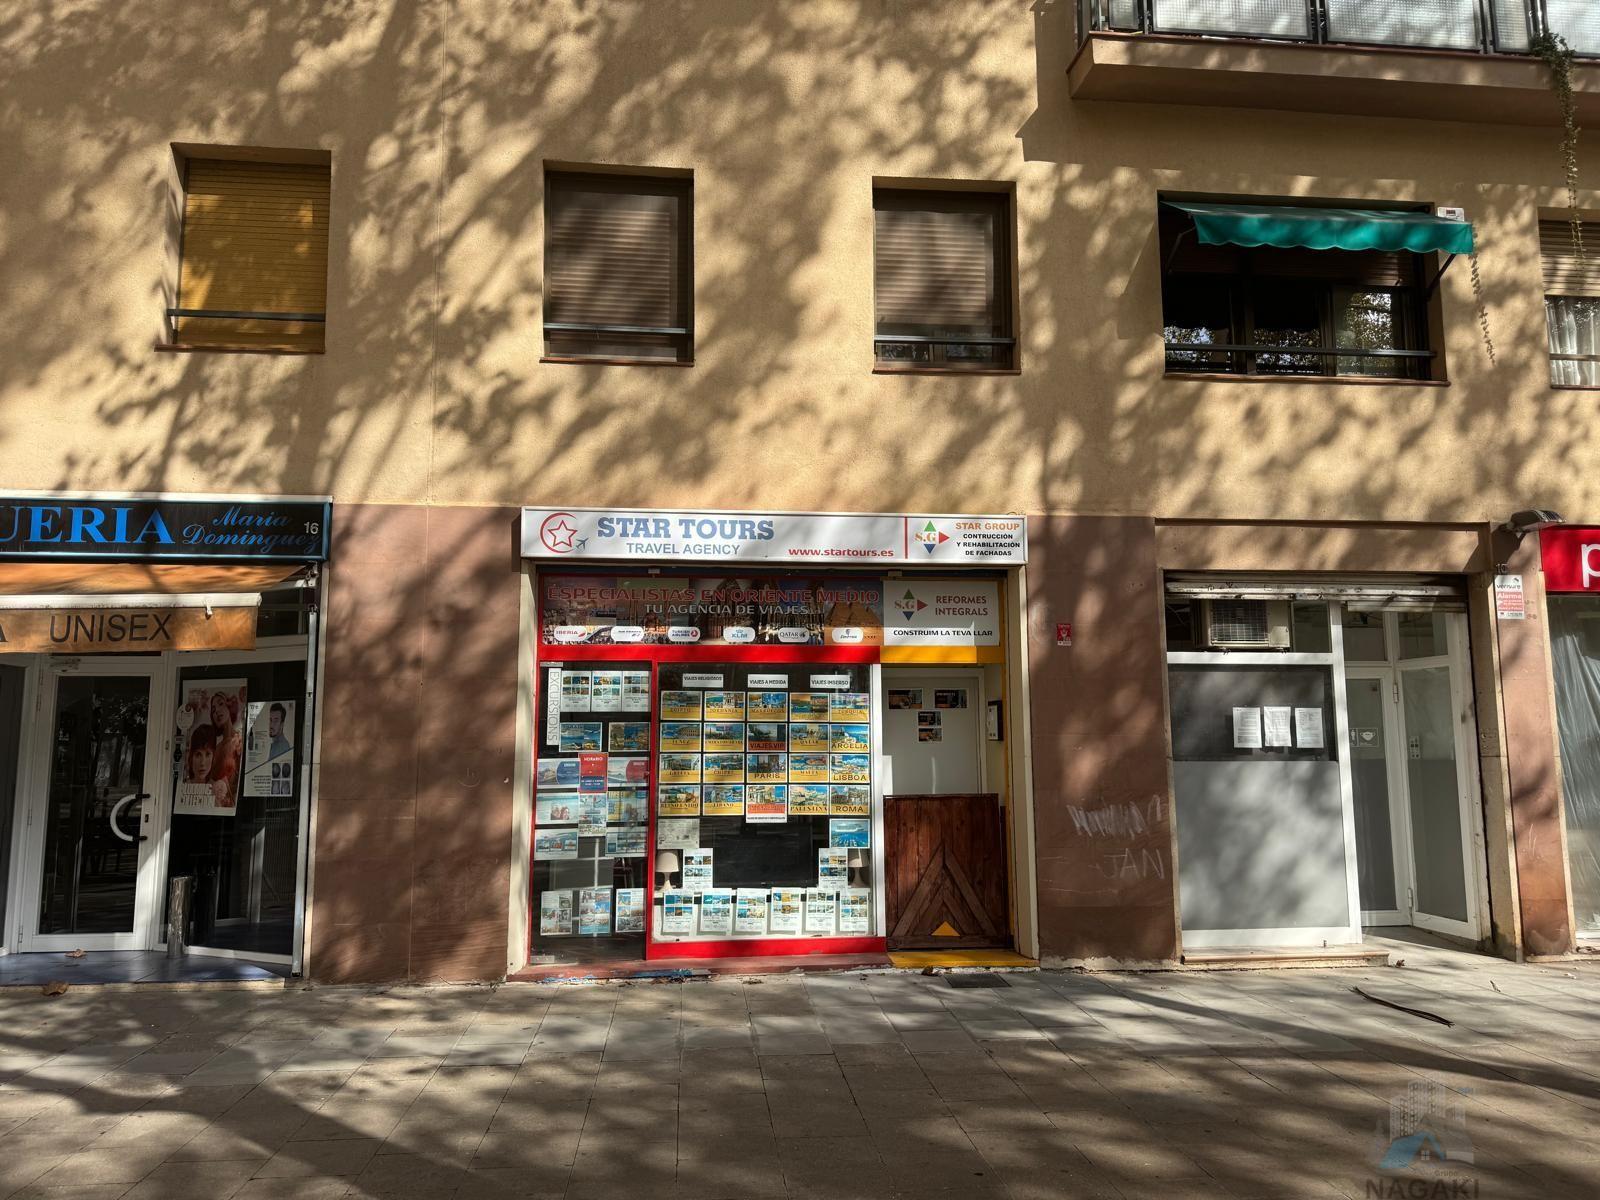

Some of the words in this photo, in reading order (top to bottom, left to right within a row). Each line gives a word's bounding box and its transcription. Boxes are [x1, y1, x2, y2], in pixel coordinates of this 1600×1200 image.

[303, 522, 320, 535] 16
[597, 517, 671, 539] STAR
[679, 519, 774, 540] TOURS
[955, 522, 981, 530] STAR
[984, 523, 1020, 531] GROUP
[626, 542, 680, 554] TRAVEL
[683, 543, 740, 555] AGENCY
[788, 547, 894, 557] www.startours.es
[547, 586, 696, 602] ESPECIALISTAS
[702, 588, 726, 602] EN
[730, 588, 812, 603] ORIENTE
[816, 589, 880, 603] MEDIO
[935, 595, 987, 605] REFORMES
[646, 604, 663, 614] TU
[667, 604, 731, 614] AGENCIA
[736, 604, 755, 614] DE
[758, 605, 810, 615] VIAJES
[935, 607, 988, 616] INTEGRALS
[50, 613, 172, 643] UNISEX
[547, 671, 560, 742] EXCURSIONS
